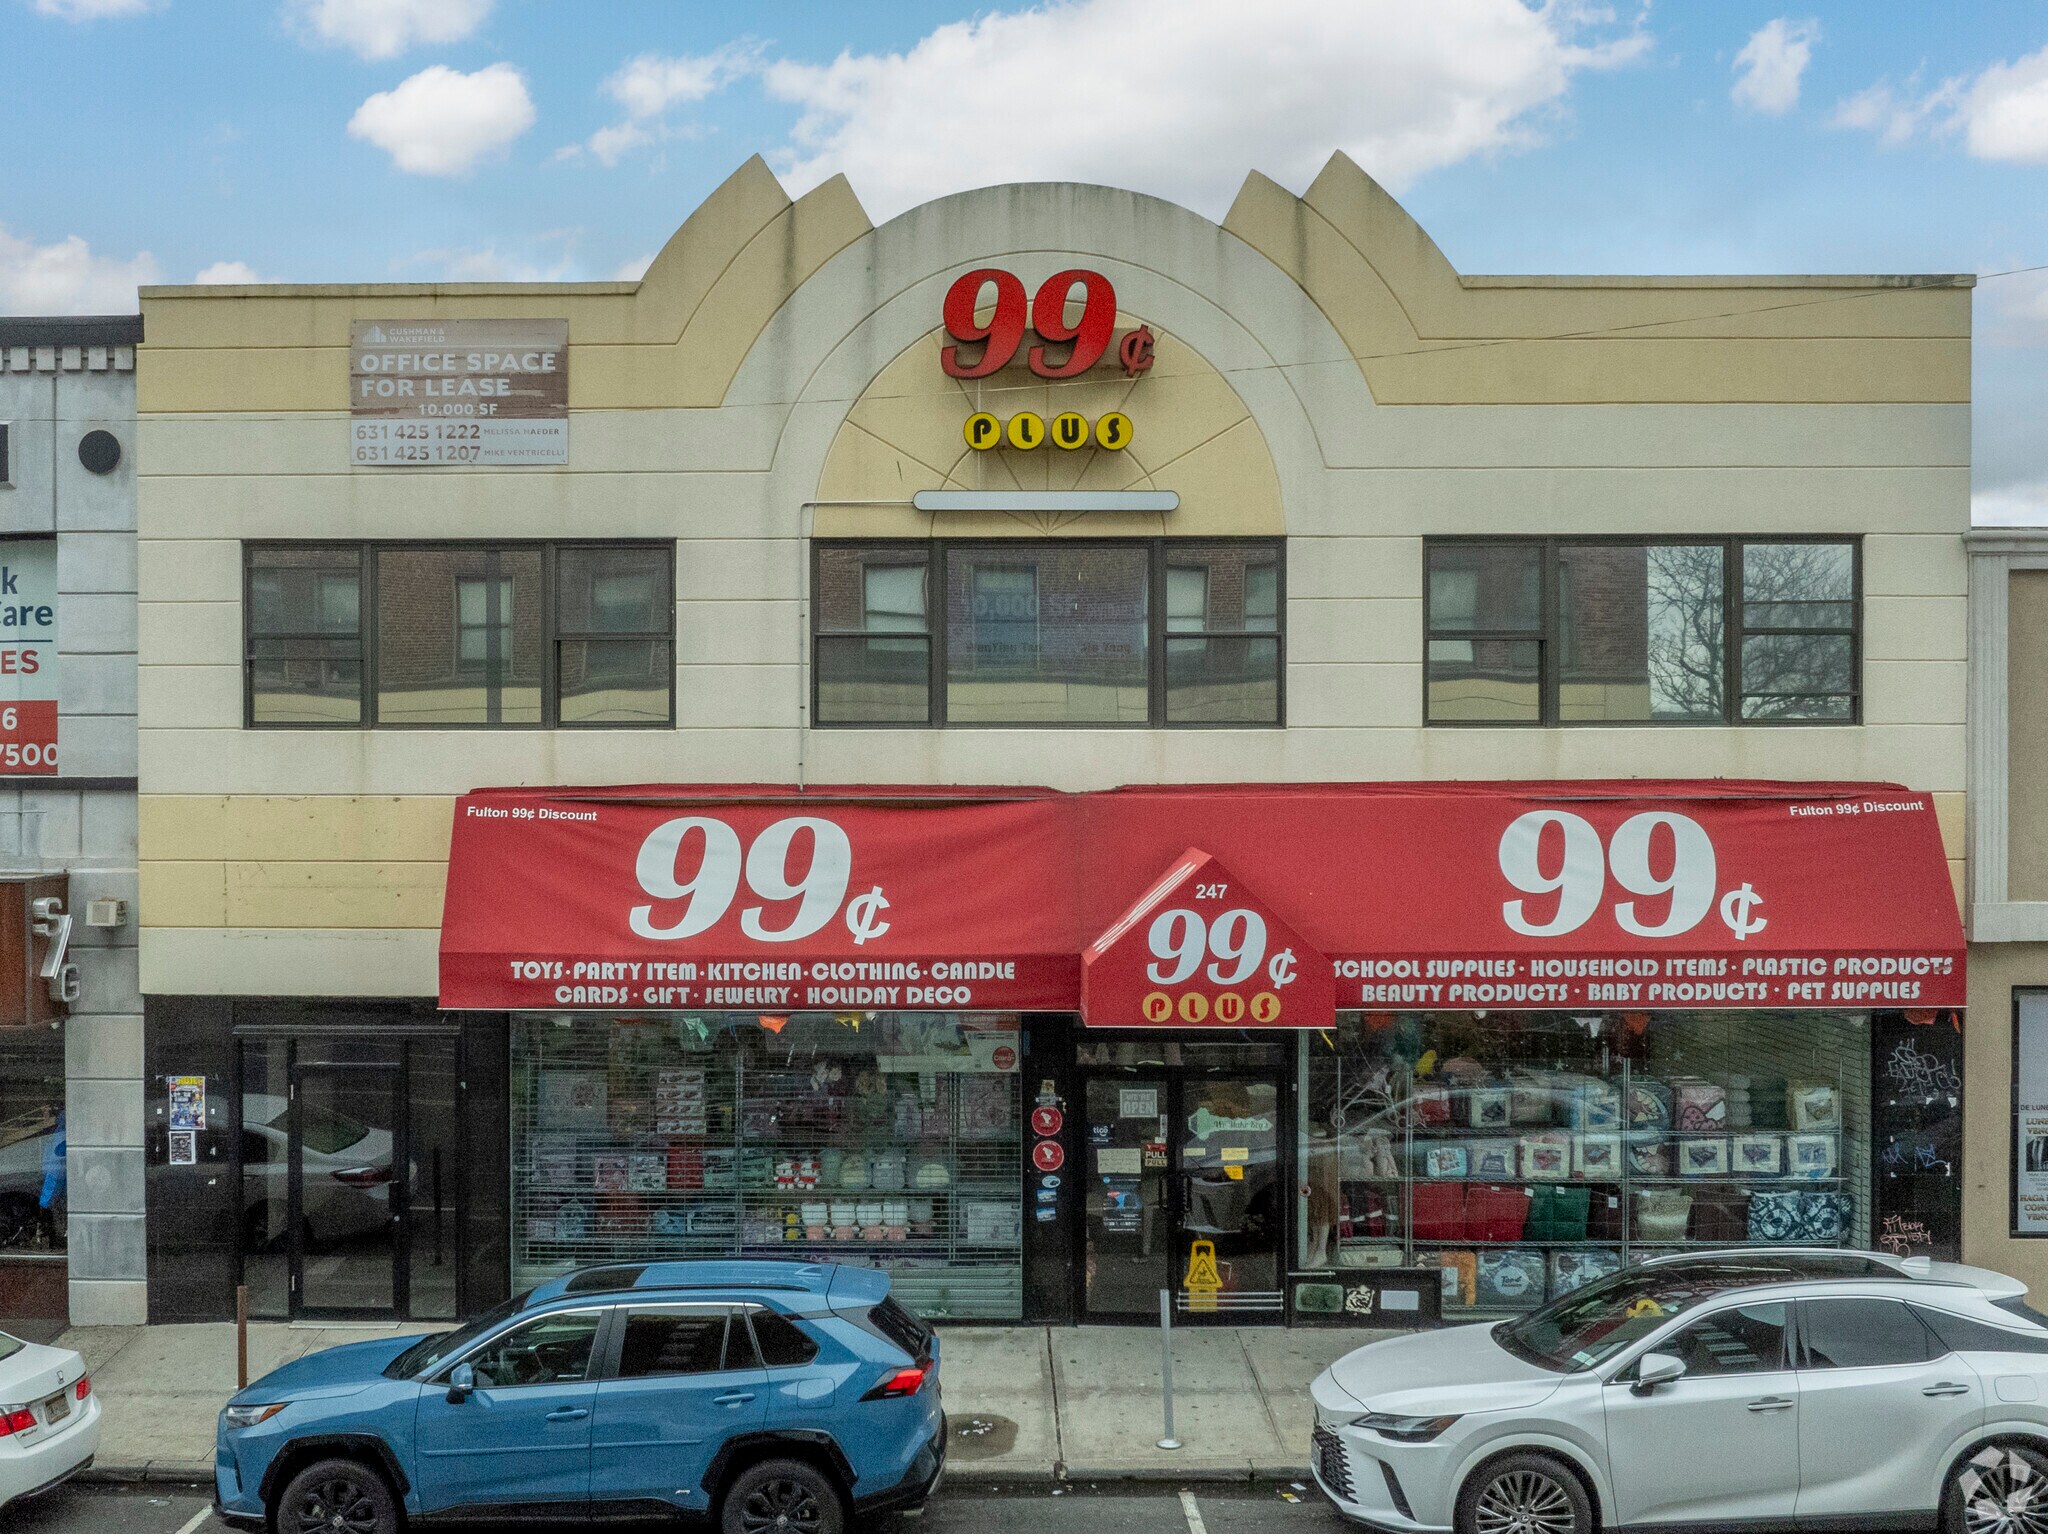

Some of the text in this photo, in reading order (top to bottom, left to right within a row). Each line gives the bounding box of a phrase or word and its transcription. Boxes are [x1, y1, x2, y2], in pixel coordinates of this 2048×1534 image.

[389, 328, 437, 336] CUSHMAN
[941, 268, 1155, 380] 99¢
[389, 336, 446, 344] WAKEFIELD
[360, 353, 556, 372] OFFICE SPACE
[361, 379, 511, 397] FOR LEASE
[418, 404, 498, 417] 10,000 SF
[356, 425, 389, 440] 631
[394, 425, 430, 440] 425
[435, 424, 481, 440] 1222
[973, 418, 1121, 444] PLUS
[356, 446, 389, 460] 631
[394, 446, 430, 460] 425
[435, 446, 481, 460] 1207
[0, 605, 53, 627] are
[0, 743, 58, 766] 500
[467, 806, 597, 821] Fulton 99¢ Discount
[1789, 800, 1924, 816] Fulton 99¢ Discount
[629, 816, 891, 945] 99¢
[1498, 809, 1768, 941] 99¢
[1195, 884, 1228, 899] 247
[1146, 908, 1297, 990] 99¢
[511, 961, 1015, 981] TOYS PARTY ITEM KITCHEN CLOTHING CANDLE
[1333, 957, 1953, 979] SCHOOL SUPPLIES HOUSEHOLD ITEMS PLASTIC PRODUCTS
[554, 986, 972, 1005] CARDS GIFT JEWELRY HOLIDAY DECO
[1362, 981, 1921, 1003] BEAUTY PRODUCTS BABY PRODUCTS PET SUPPLIES
[1150, 998, 1270, 1019] PLUS
[1123, 1101, 1153, 1114] OPEN
[1145, 1151, 1167, 1159] PULL
